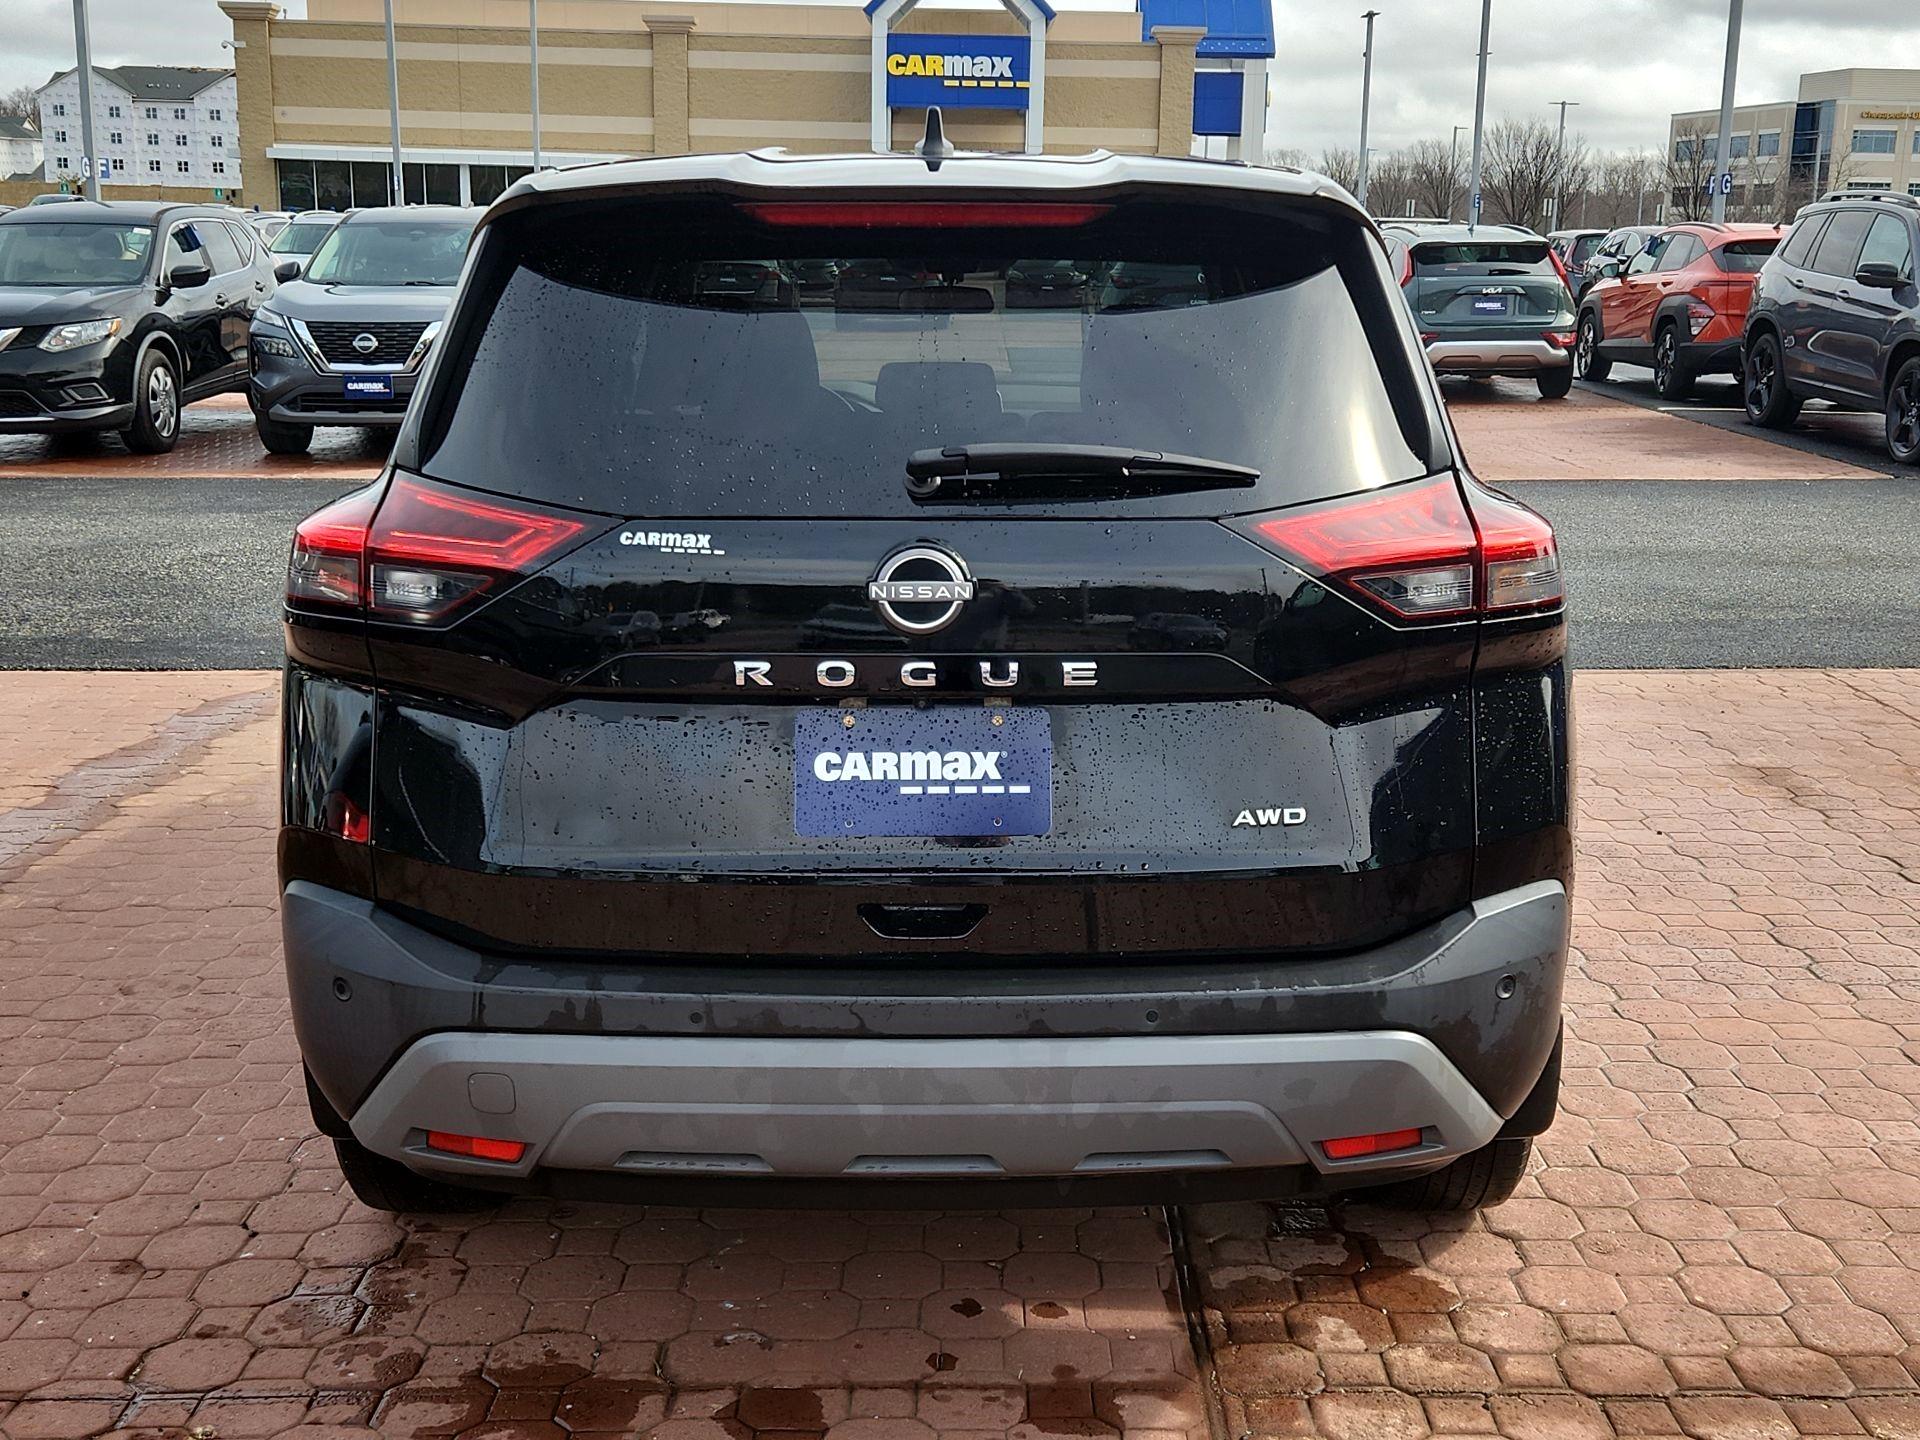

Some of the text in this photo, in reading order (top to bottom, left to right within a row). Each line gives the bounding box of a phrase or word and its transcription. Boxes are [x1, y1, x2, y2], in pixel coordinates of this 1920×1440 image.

[887, 53, 1013, 78] CARmax
[82, 156, 91, 178] G
[98, 157, 107, 180] F
[1722, 174, 1731, 194] G
[619, 531, 712, 549] CARmax
[871, 585, 971, 599] NISSAN
[733, 660, 1099, 688] ROGUE
[1231, 807, 1308, 827] AWD
